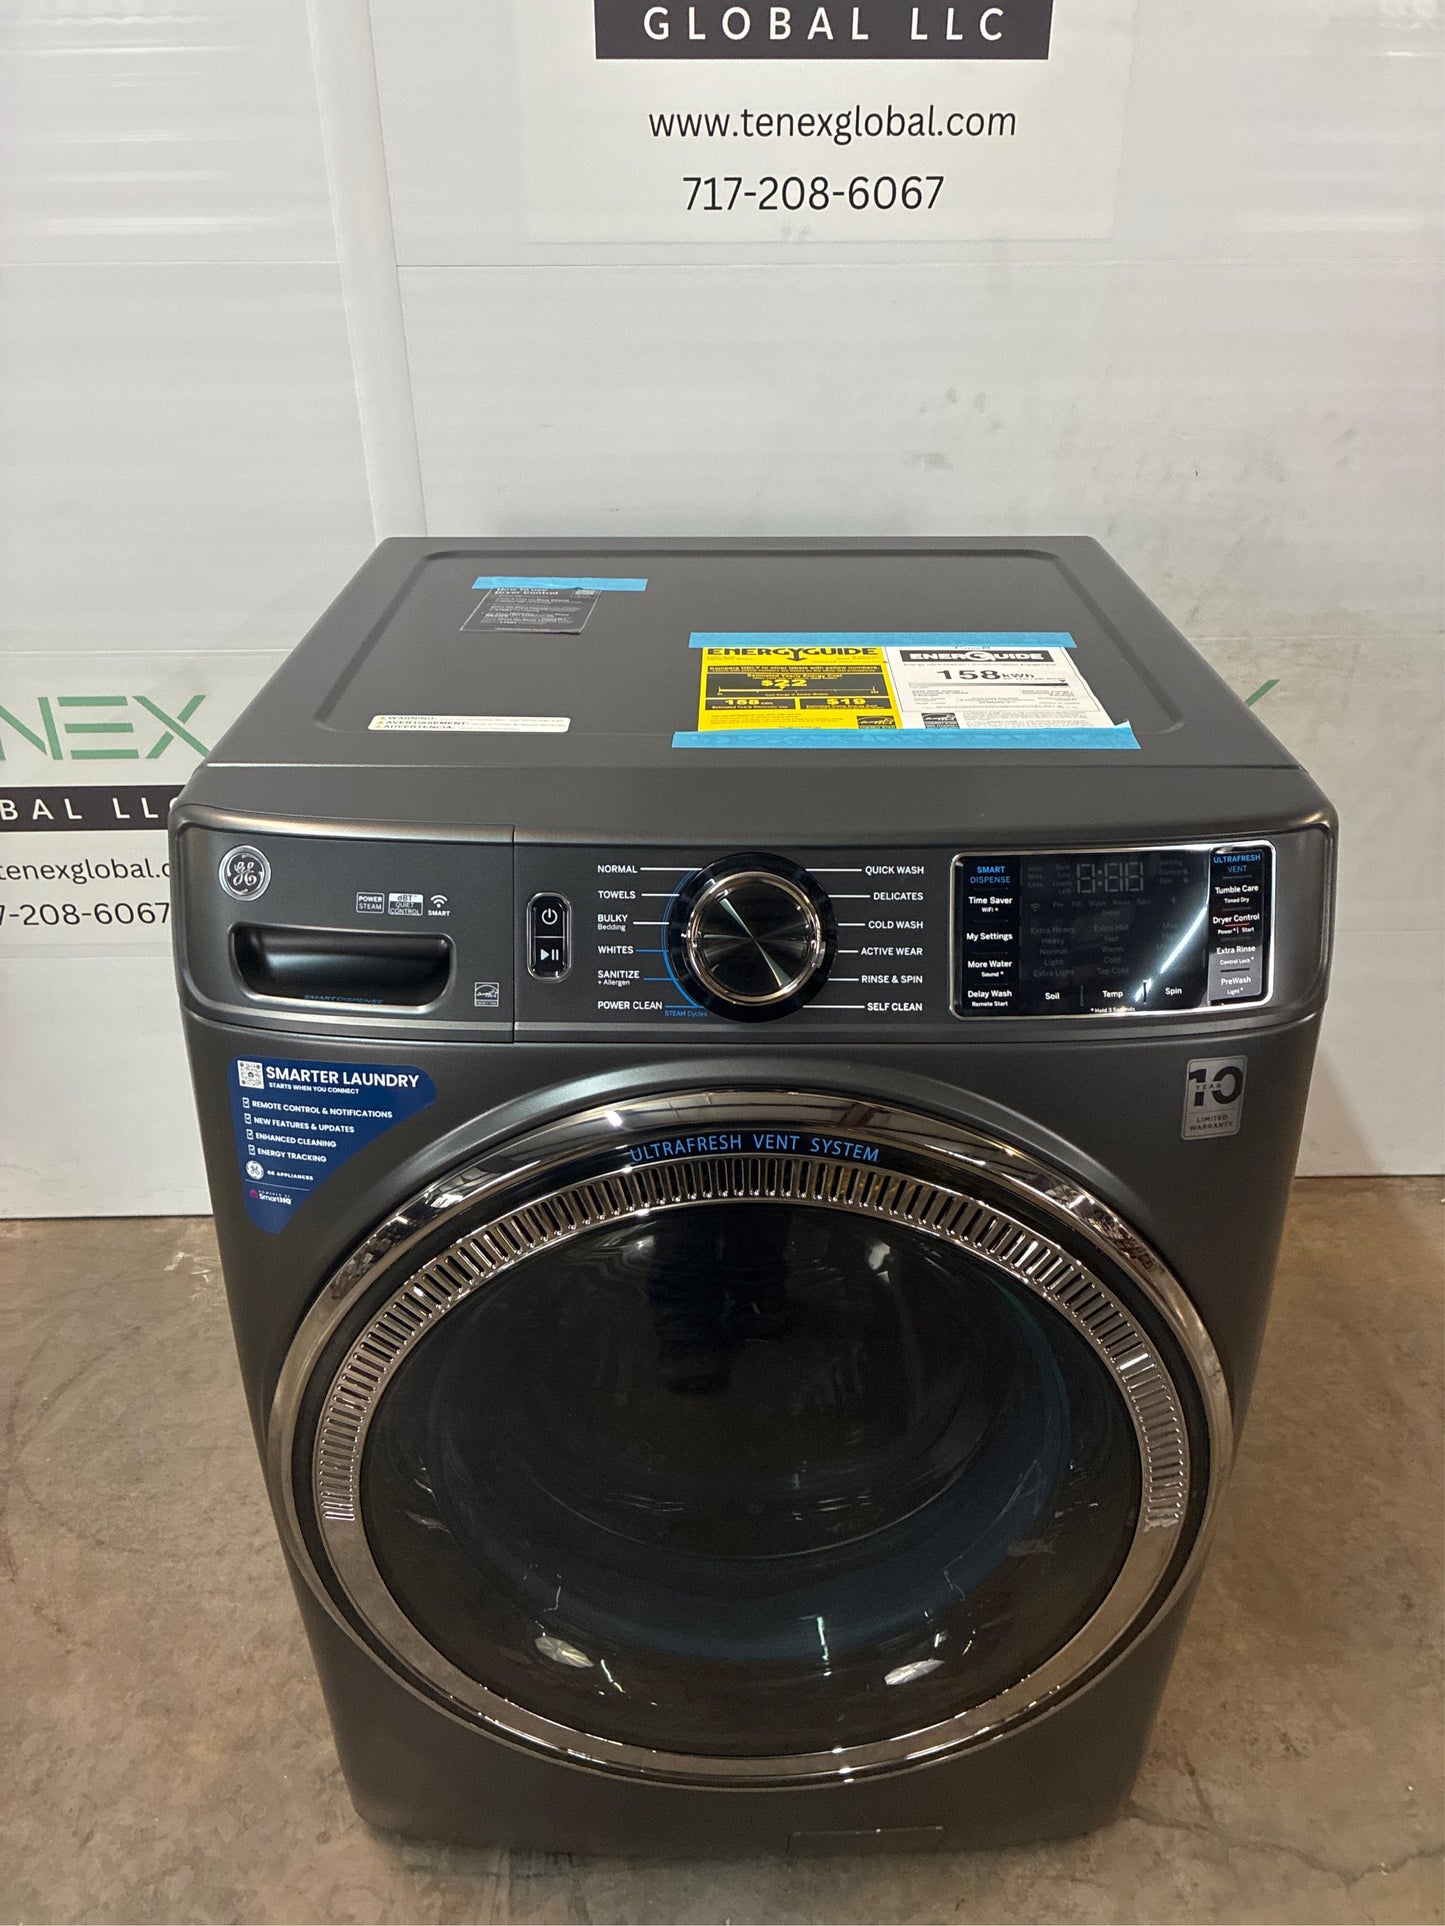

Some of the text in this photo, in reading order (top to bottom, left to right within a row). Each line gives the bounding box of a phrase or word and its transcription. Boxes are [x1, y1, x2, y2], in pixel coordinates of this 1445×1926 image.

[643, 6, 1004, 41] GLOBAL LLC
[648, 104, 1017, 146] www.tenexglobal.com
[682, 175, 946, 211] 717-208-6067
[936, 669, 1001, 680] 158
[0, 695, 211, 761] NEX
[0, 796, 178, 821] BAL LL
[1213, 854, 1261, 864] ULTRAFRESH
[233, 861, 257, 886] GE
[597, 865, 638, 873] NORMAL
[865, 865, 925, 876] QUICK WASH
[1228, 865, 1247, 873] VENT
[970, 876, 1012, 884] DISPENSE
[1215, 886, 1240, 894] Tumble
[597, 891, 636, 899] TOWELS
[873, 892, 924, 901] DELICATES
[968, 896, 1013, 904] Time Saver
[597, 914, 628, 922] BULKY
[1213, 913, 1260, 925] Dryer Control
[597, 924, 626, 932] Bedding
[868, 921, 924, 929] COLD WASH
[966, 932, 1013, 941] My Settings
[597, 946, 634, 954] WHITES
[860, 947, 923, 956] ACTIVE WEAR
[597, 970, 640, 979] SANITIZE
[603, 979, 630, 987] Allergen
[861, 975, 923, 984] RINSE & SPIN
[1220, 976, 1251, 985] PreWash
[968, 991, 989, 999] Delay
[1045, 992, 1061, 1000] Soil
[1102, 990, 1124, 998] Temp
[1165, 987, 1183, 996] Spin
[597, 1001, 663, 1010] POWER CLEAN
[867, 1003, 923, 1011] SELF CLEAN
[687, 1010, 708, 1018] Cycles
[265, 1066, 420, 1088] SMARTER LAUNDRY
[268, 1082, 360, 1095] STARTS WHEN YOU CONNECT
[1188, 1066, 1244, 1107] 10
[251, 1100, 393, 1118] REMOTE CONTROL & NOTIFICATIONS
[1196, 1114, 1228, 1123] LIMITED
[253, 1117, 271, 1126] NEW
[272, 1119, 310, 1130] FEATURES
[318, 1124, 355, 1133] UPDATES
[1190, 1122, 1233, 1131] WARRANTY
[255, 1132, 337, 1148] ENHANCED CLEANING
[630, 1134, 880, 1162] ULTRAFRESH VENT SYSTEM
[257, 1147, 327, 1163] ENERGY TRACKING
[276, 1171, 314, 1181] APPLIANCES
